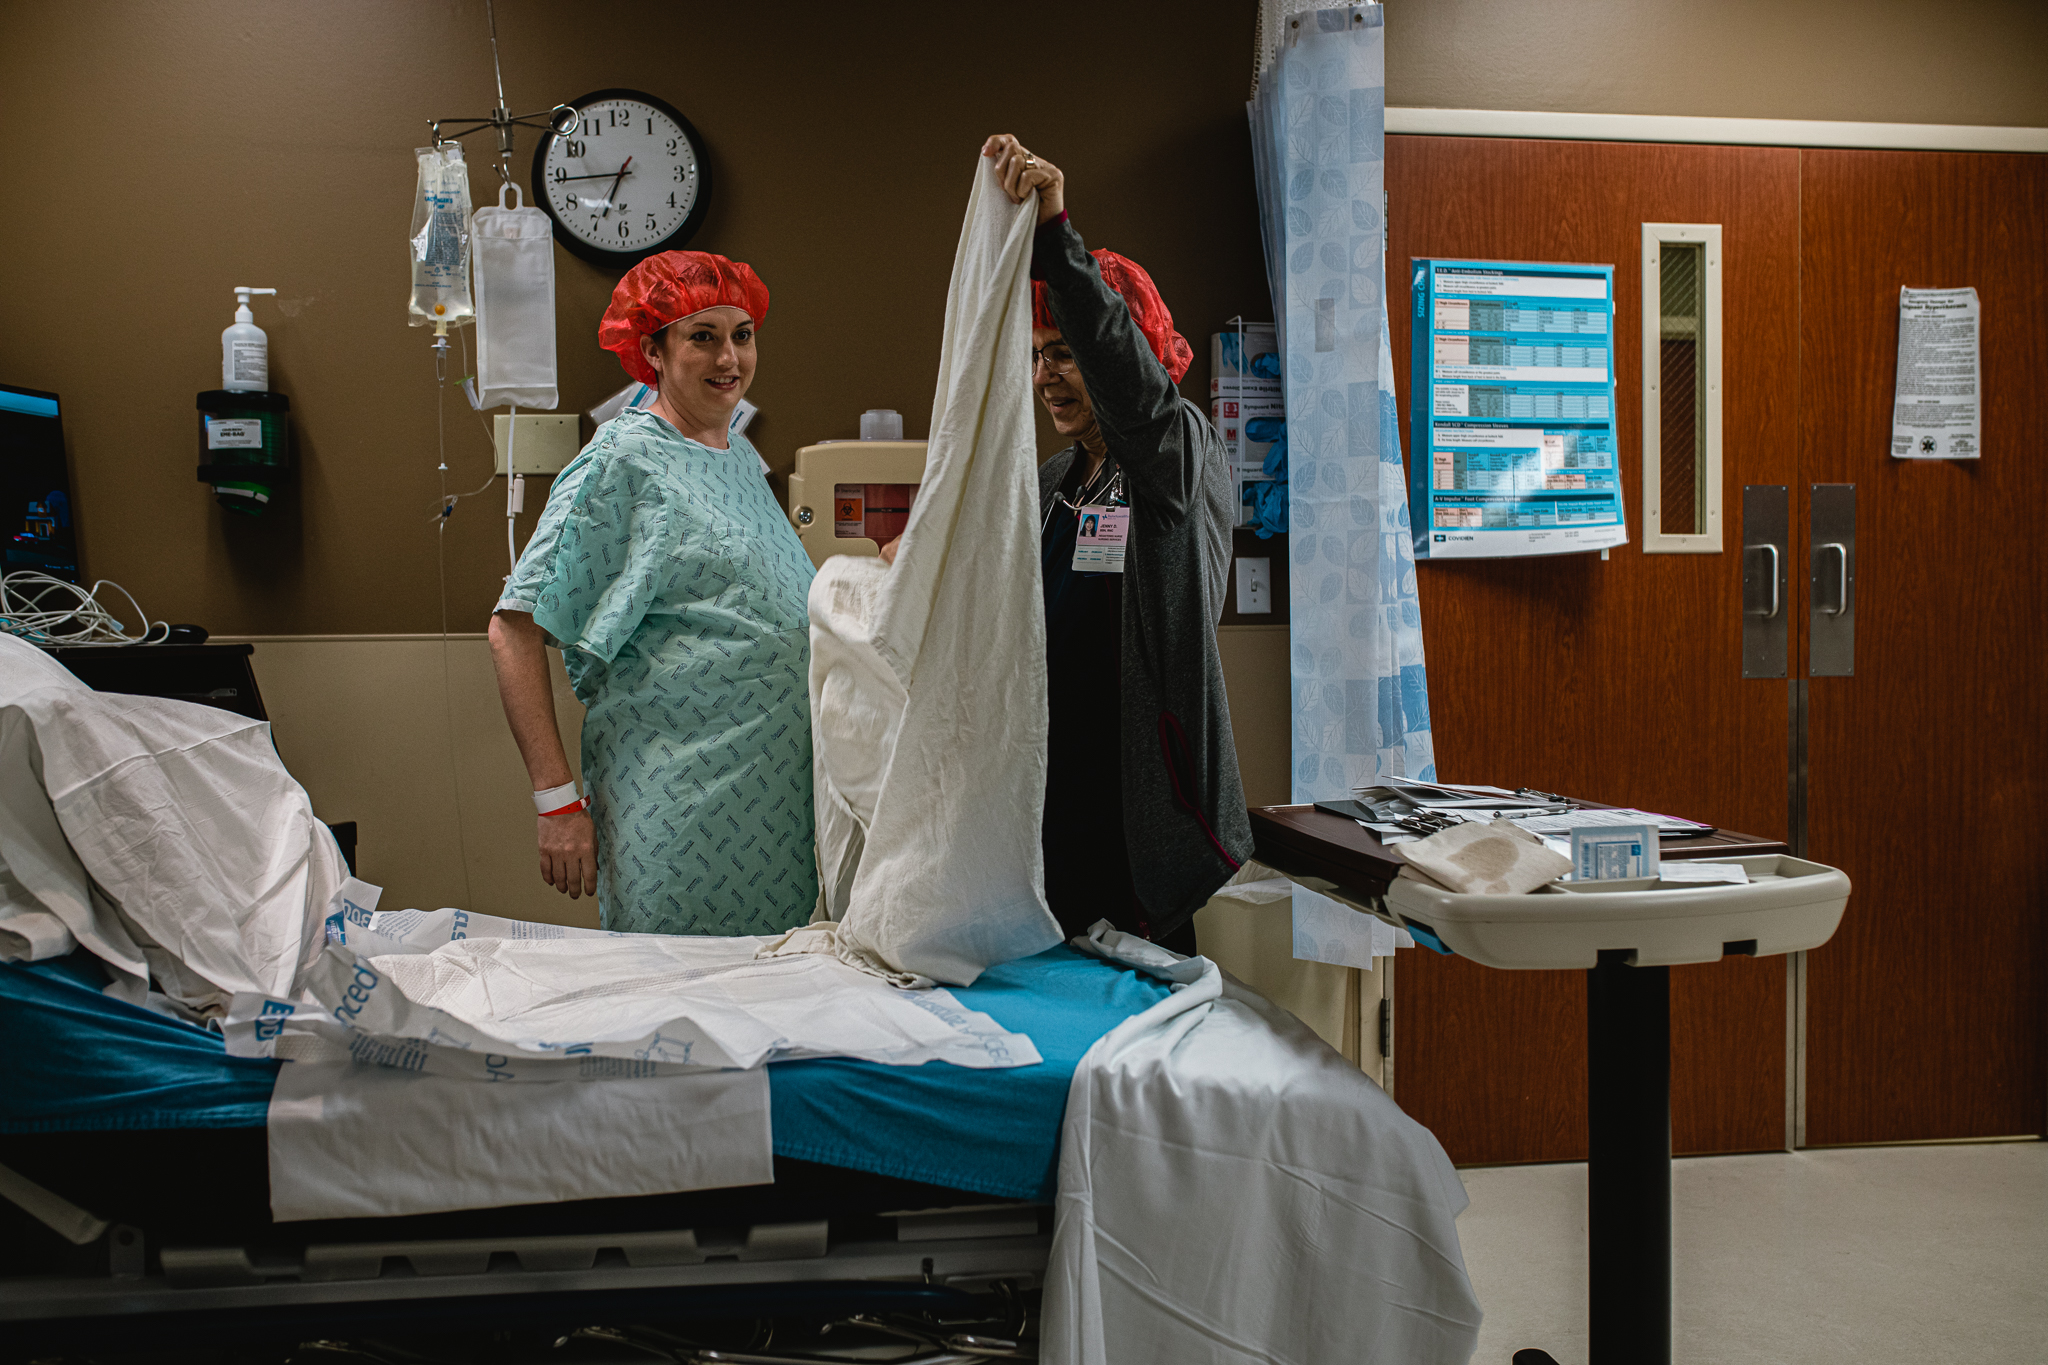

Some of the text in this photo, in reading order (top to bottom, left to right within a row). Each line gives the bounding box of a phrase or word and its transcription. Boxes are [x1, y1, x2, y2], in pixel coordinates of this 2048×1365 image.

[583, 119, 602, 136] 11
[608, 109, 630, 128] 12
[645, 118, 656, 136] 1
[565, 140, 586, 158] 10
[666, 139, 678, 157] 2
[556, 167, 568, 185] 9
[674, 165, 685, 183] 3
[566, 193, 578, 211] 8
[666, 191, 678, 208] 4
[590, 214, 601, 232] 7
[618, 220, 630, 238] 6
[646, 213, 657, 231] 5
[1418, 292, 1426, 318] SIZING
[1227, 429, 1236, 440] M
